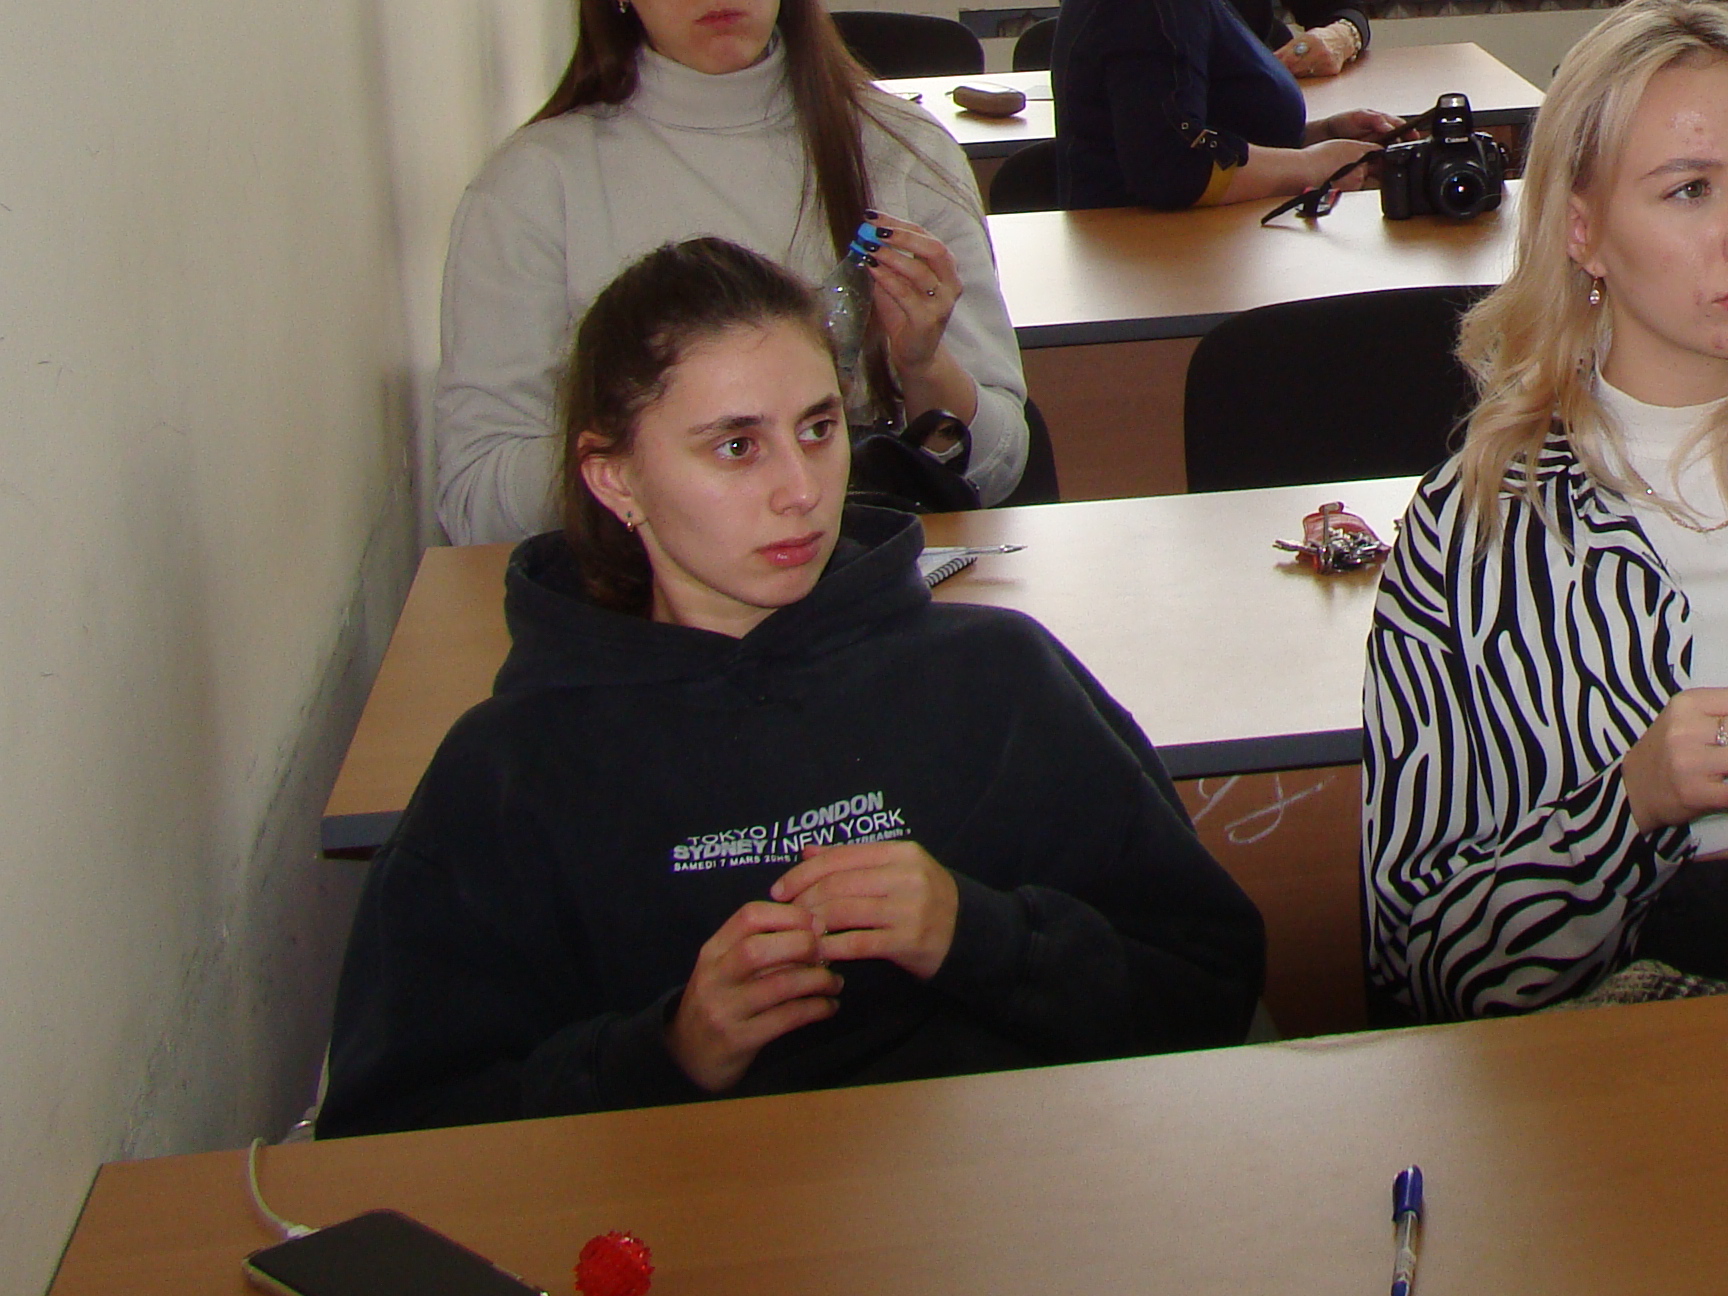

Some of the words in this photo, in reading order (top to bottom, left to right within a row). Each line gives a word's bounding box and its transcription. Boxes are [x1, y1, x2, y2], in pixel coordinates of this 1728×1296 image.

[673, 838, 769, 860] SYDNEY
[839, 808, 905, 839] YORK
[687, 825, 767, 845] TOKYO
[786, 790, 884, 835] LONDON
[673, 861, 717, 872] SAMEDI
[720, 858, 727, 868] 7
[730, 855, 761, 867] MARS
